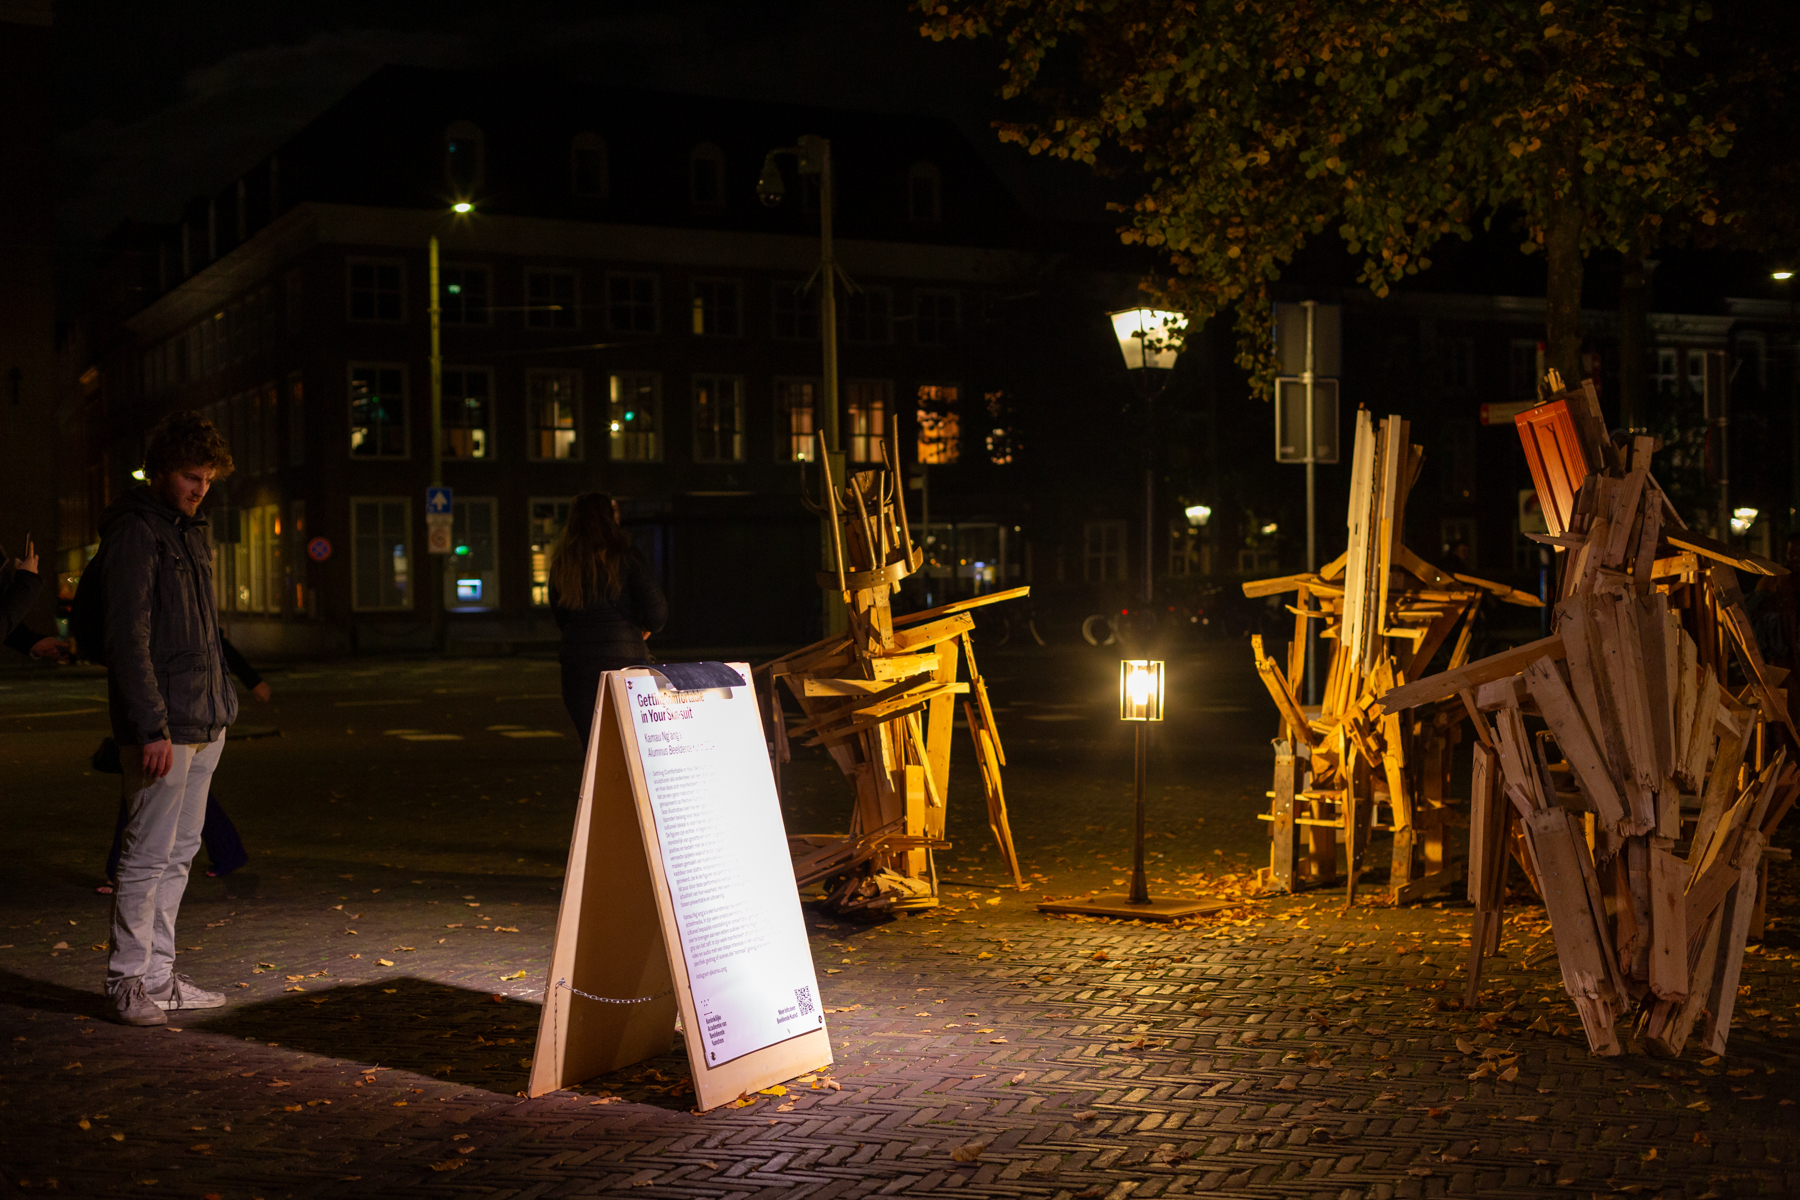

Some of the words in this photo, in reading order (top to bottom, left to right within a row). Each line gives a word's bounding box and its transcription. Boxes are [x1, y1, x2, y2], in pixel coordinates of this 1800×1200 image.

[640, 710, 649, 723] in
[648, 709, 666, 722] Your
[644, 732, 662, 743] Kamau
[648, 746, 669, 757] Alumnus
